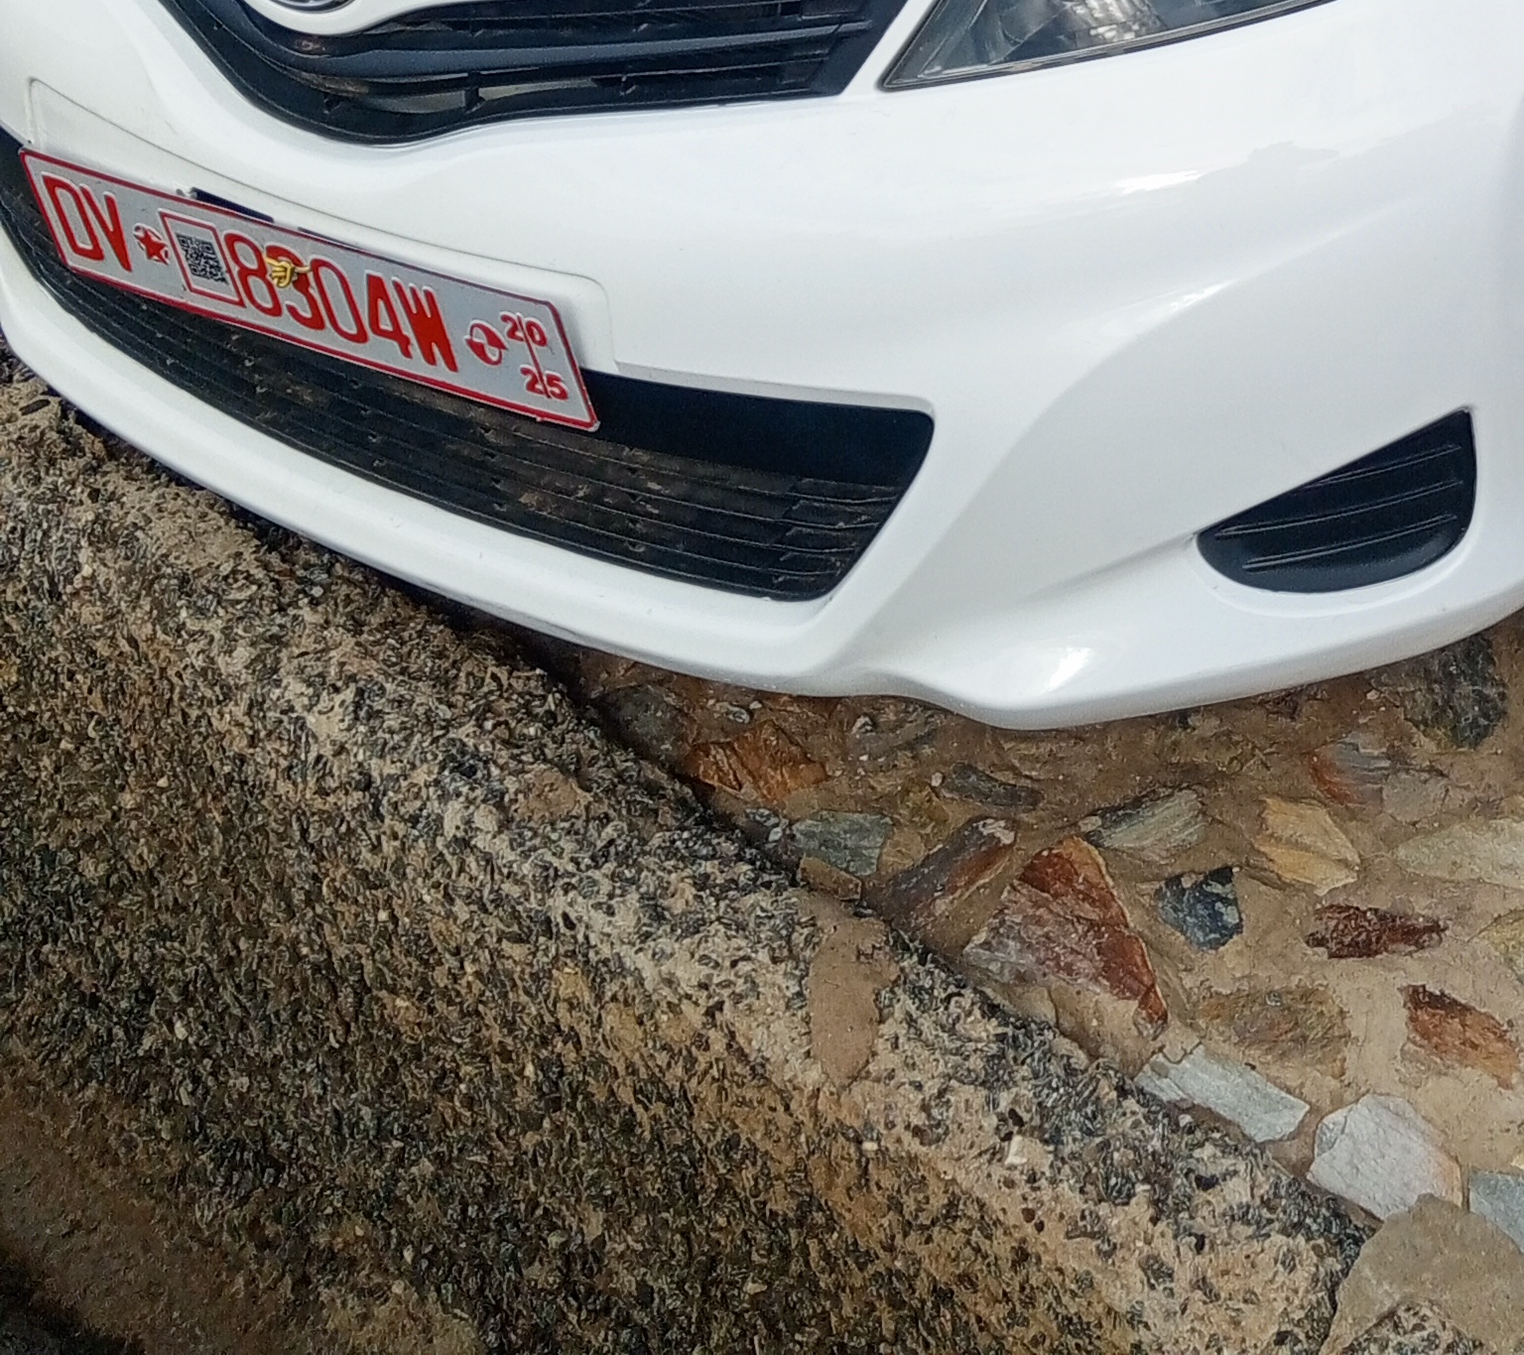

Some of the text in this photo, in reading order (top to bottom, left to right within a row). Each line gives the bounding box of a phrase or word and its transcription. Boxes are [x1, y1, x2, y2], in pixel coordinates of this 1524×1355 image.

[42, 172, 459, 373] DV 8304W
[500, 312, 548, 348] 20
[520, 365, 569, 401] 25
